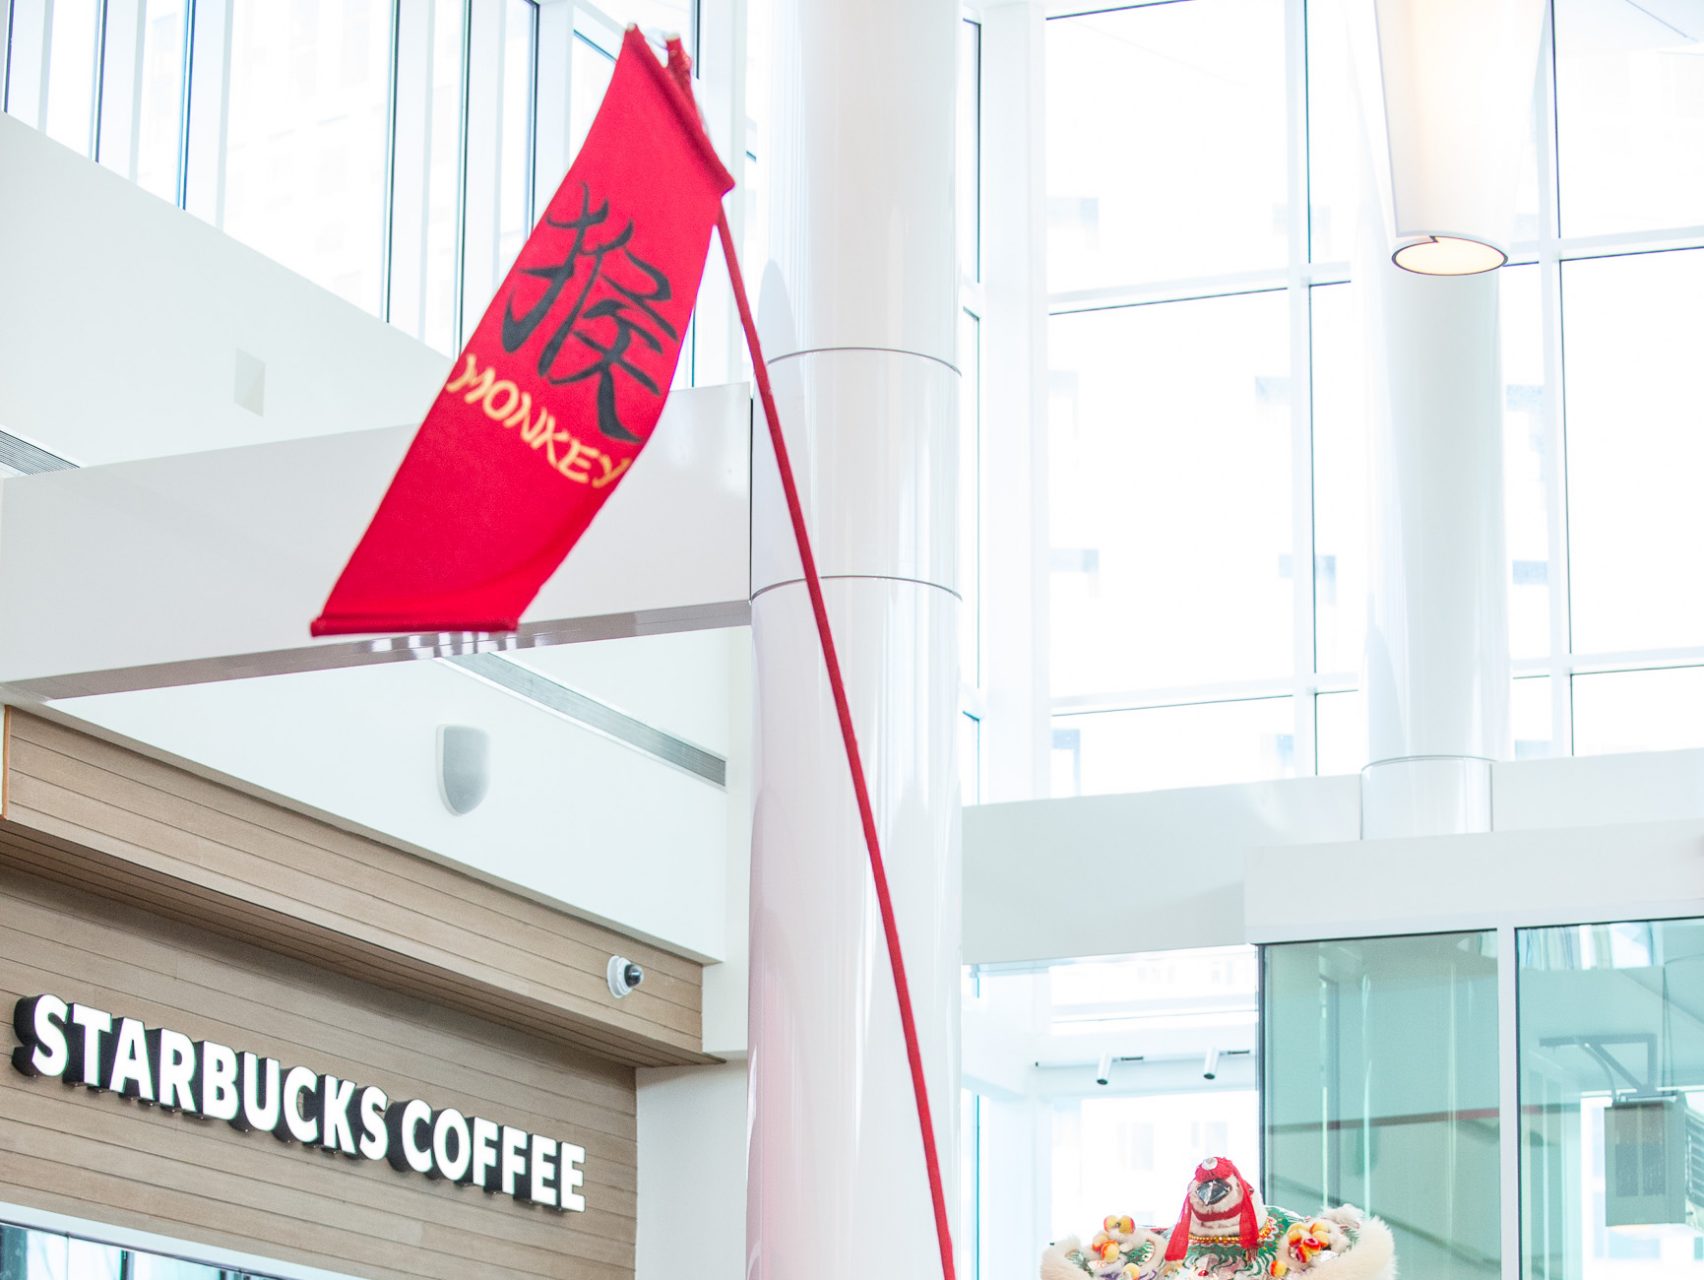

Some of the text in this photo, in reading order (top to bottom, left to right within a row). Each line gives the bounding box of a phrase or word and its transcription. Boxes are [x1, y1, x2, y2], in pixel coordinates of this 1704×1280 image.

[446, 353, 632, 487] MONKEY
[502, 181, 679, 443] 猴
[29, 993, 587, 1212] STARBUCKS COFFEE
